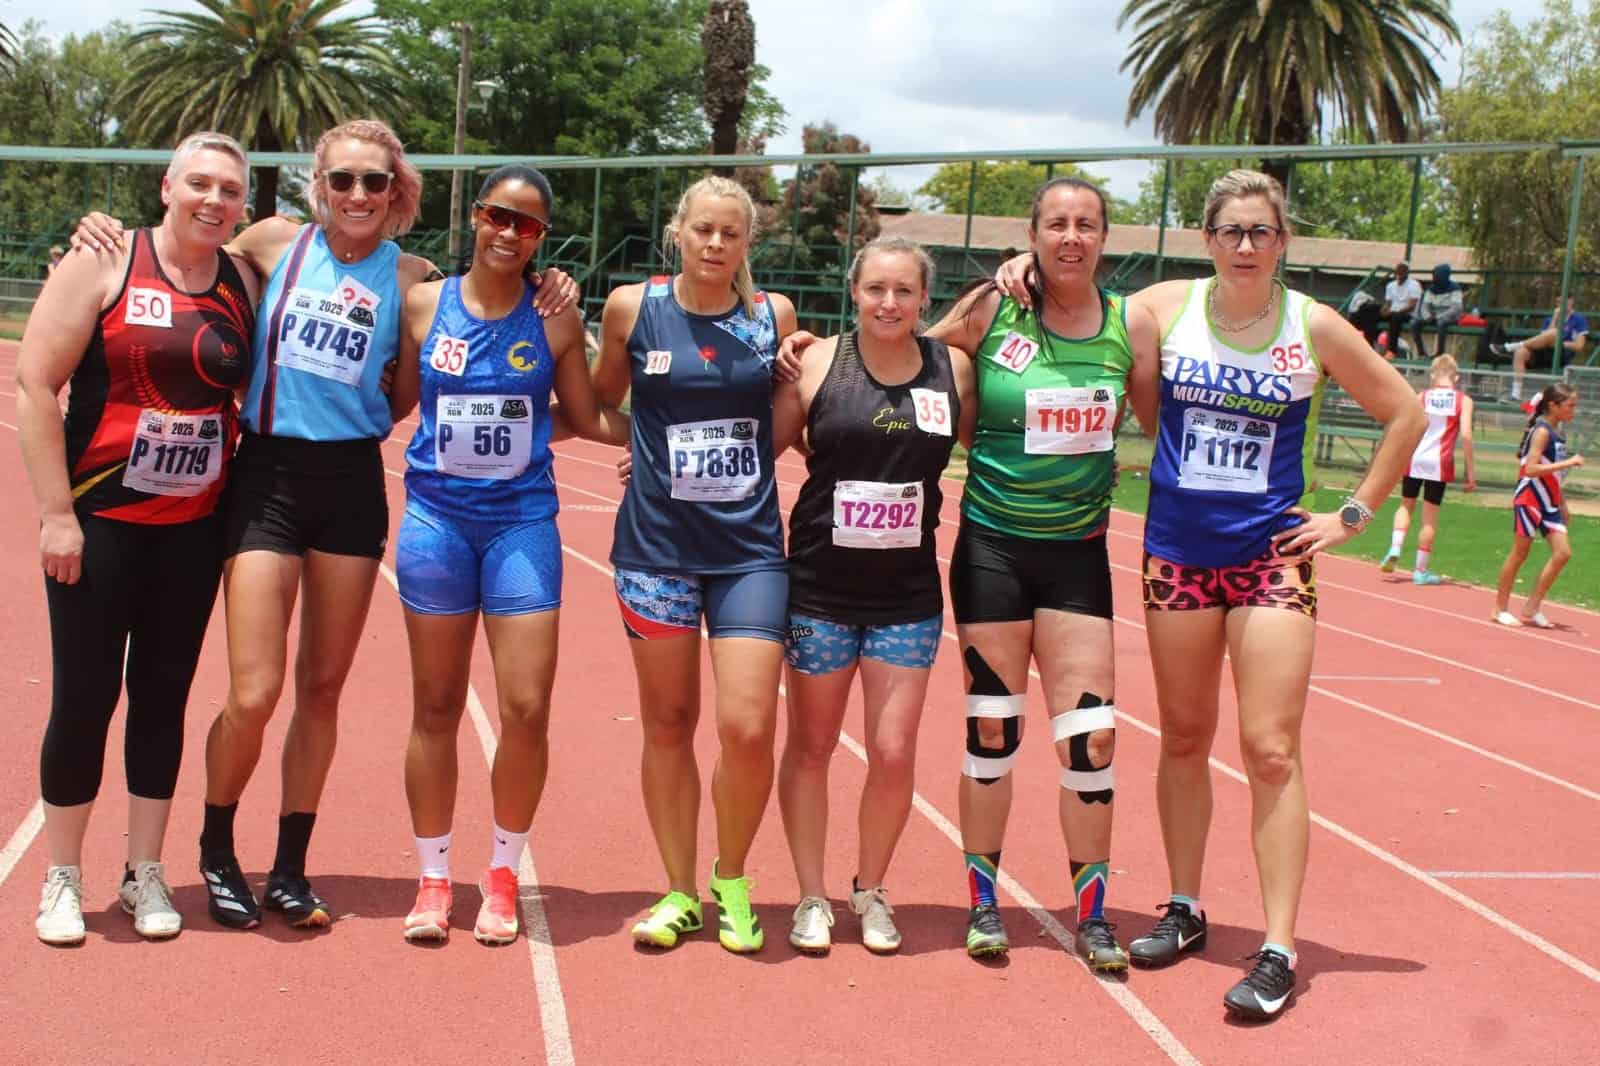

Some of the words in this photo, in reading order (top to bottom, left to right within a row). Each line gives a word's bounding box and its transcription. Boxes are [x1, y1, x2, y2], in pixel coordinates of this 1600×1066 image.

[132, 294, 165, 319] 50
[319, 299, 344, 316] 2025
[280, 313, 297, 342] P
[298, 318, 368, 362] 4743
[435, 339, 465, 372] 35
[1001, 338, 1032, 369] 40
[1271, 343, 1305, 373] 35
[1172, 355, 1292, 403] PARYS
[471, 403, 495, 416] 2025
[919, 396, 946, 425] 35
[1172, 383, 1289, 418] MULTISPORT
[171, 422, 194, 436] 2025
[702, 426, 726, 440] 2025
[872, 407, 913, 435] Epic
[1037, 406, 1107, 433] T1912
[1214, 418, 1239, 432] 2025
[439, 423, 453, 453] P
[473, 424, 512, 457] 56
[1184, 433, 1197, 462] P
[1205, 437, 1261, 471] 1112
[130, 437, 149, 467] P
[153, 443, 210, 475] 11719
[675, 449, 688, 478] P
[691, 446, 757, 478] 7838
[840, 500, 917, 529] T2292
